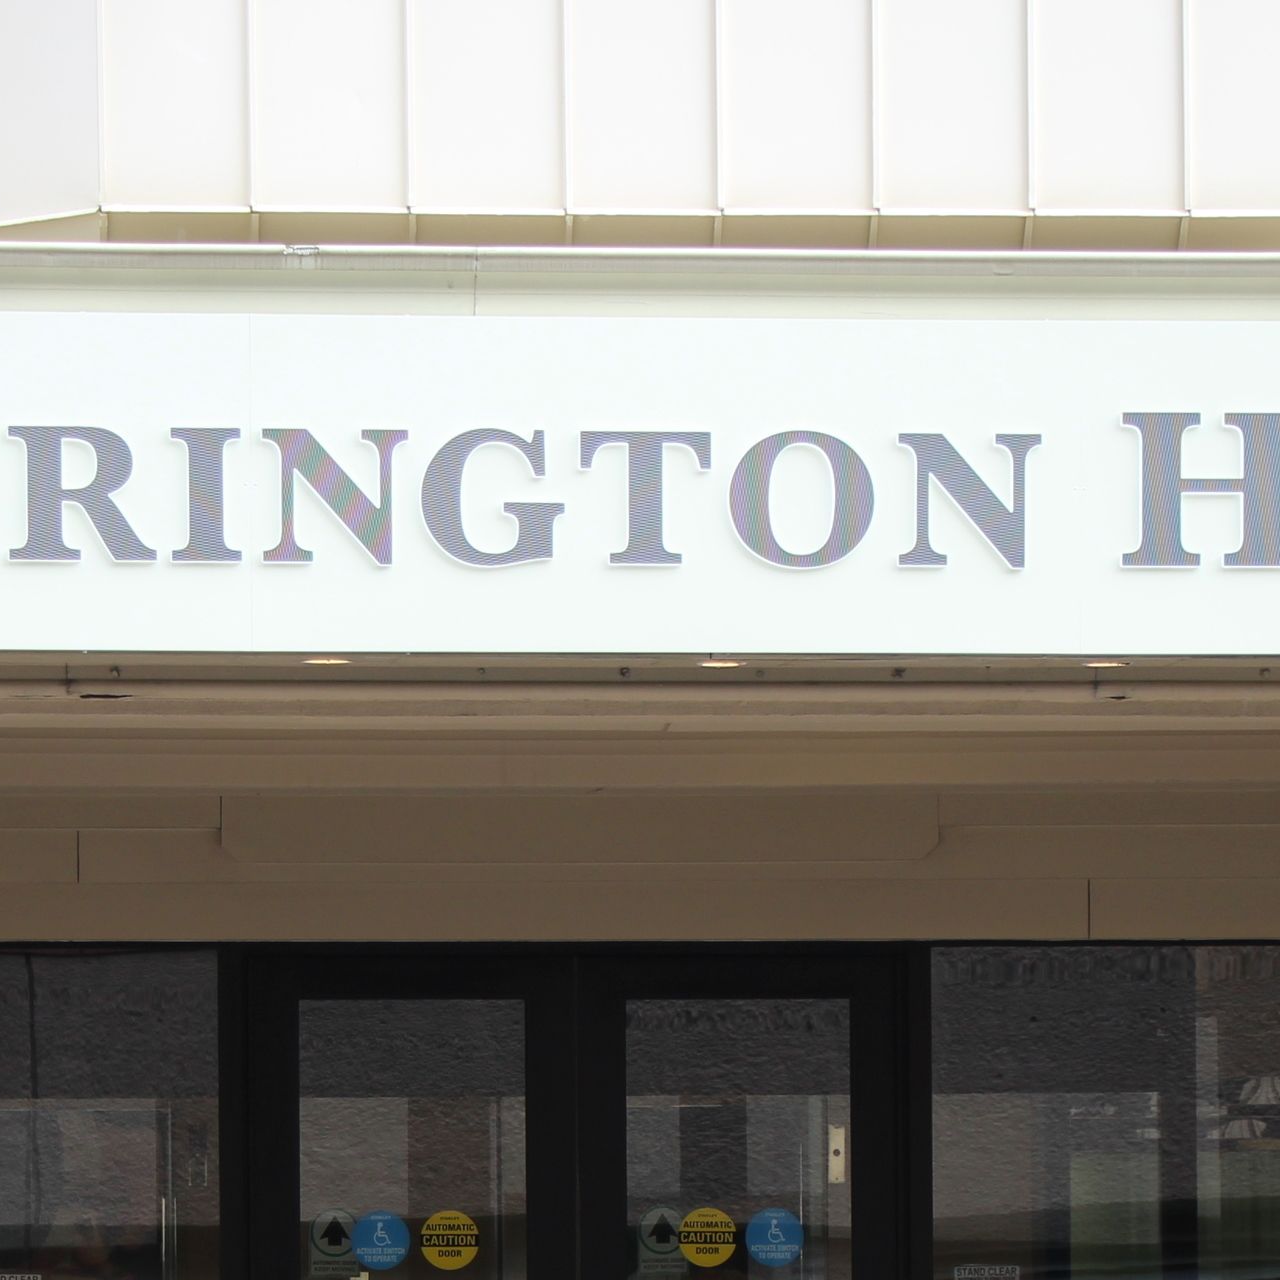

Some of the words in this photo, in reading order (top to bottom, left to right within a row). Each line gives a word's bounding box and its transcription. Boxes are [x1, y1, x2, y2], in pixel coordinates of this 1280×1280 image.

[425, 1223, 475, 1232] AUTOMATIC
[683, 1220, 733, 1229] AUTOMATIC
[423, 1235, 476, 1246] CAUTION
[680, 1232, 734, 1243] CAUTION
[437, 1250, 462, 1258] DOOR
[695, 1247, 720, 1255] DOOR
[957, 1267, 985, 1277] STAND
[987, 1267, 1017, 1276] CLEAR
